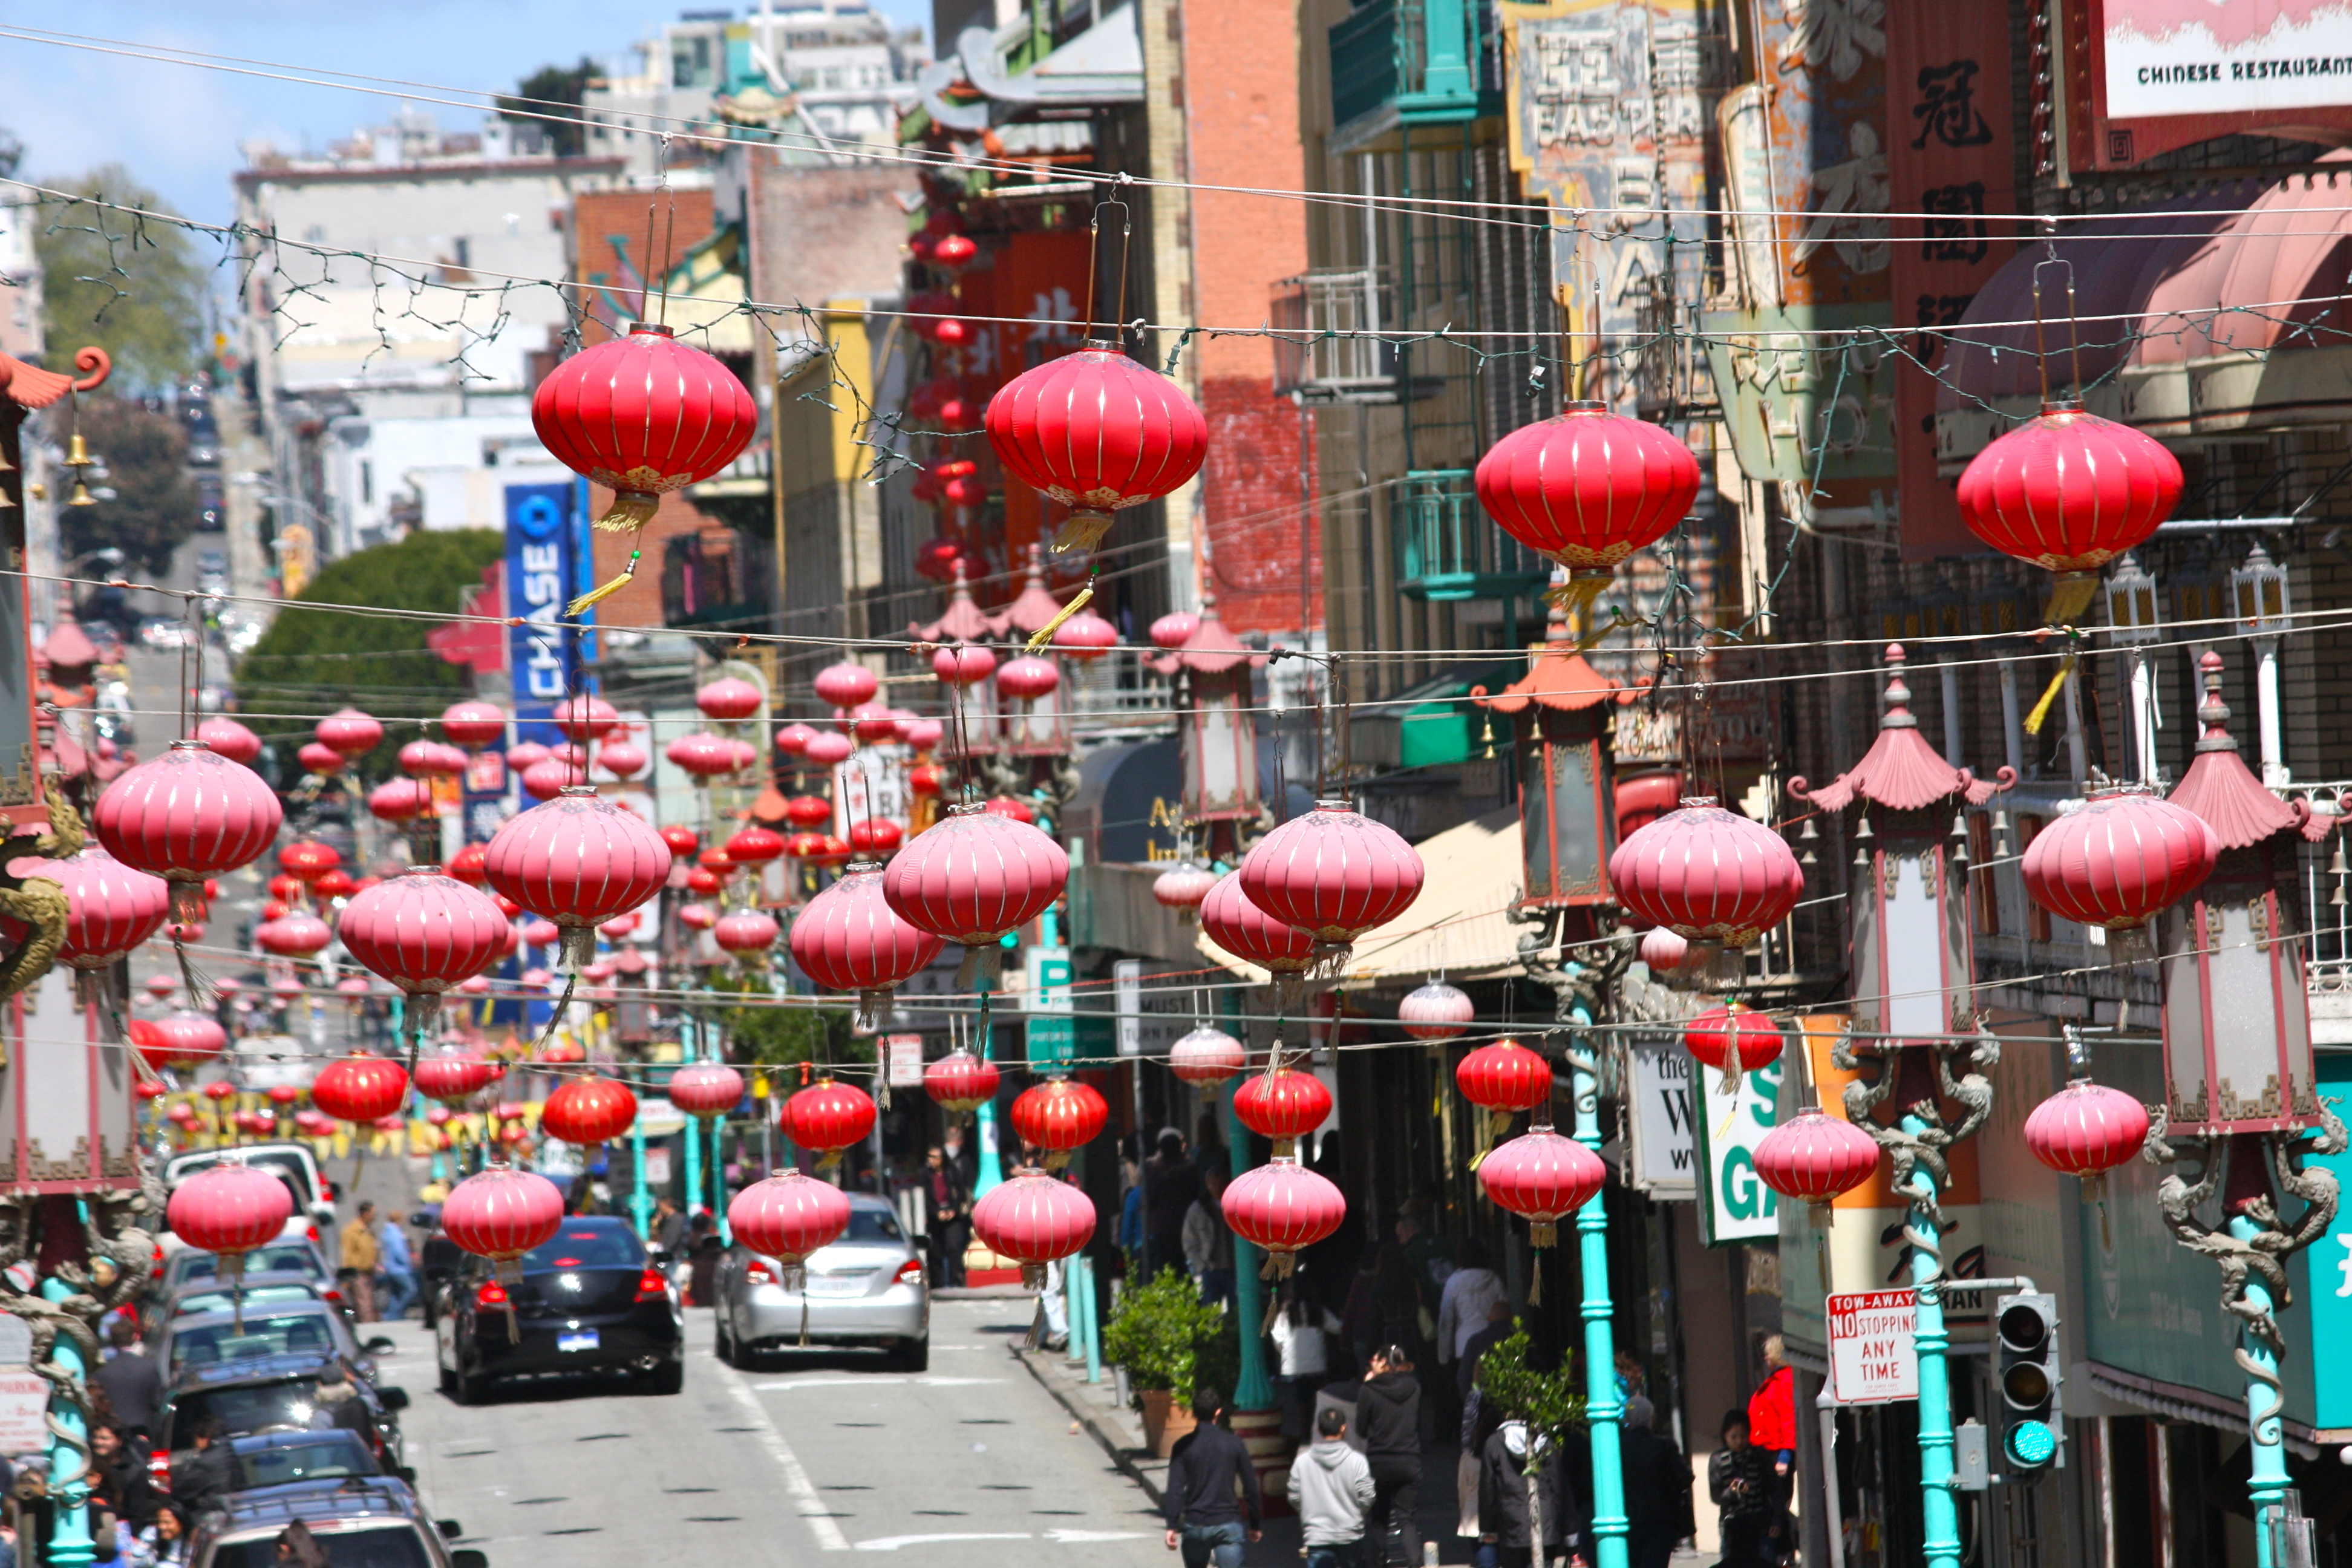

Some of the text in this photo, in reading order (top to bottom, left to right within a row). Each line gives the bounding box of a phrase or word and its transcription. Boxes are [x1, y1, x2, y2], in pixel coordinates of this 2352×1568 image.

[2137, 56, 2352, 85] CHINESE RESTAURANT
[523, 543, 566, 697] CHASE
[1140, 998, 1186, 1013] MUST
[1657, 1049, 1688, 1079] the
[1834, 1292, 1915, 1311] TOW-AWAY
[1832, 1312, 1857, 1338] NO
[1861, 1339, 1896, 1359] ANY
[1860, 1361, 1900, 1381] TIME
